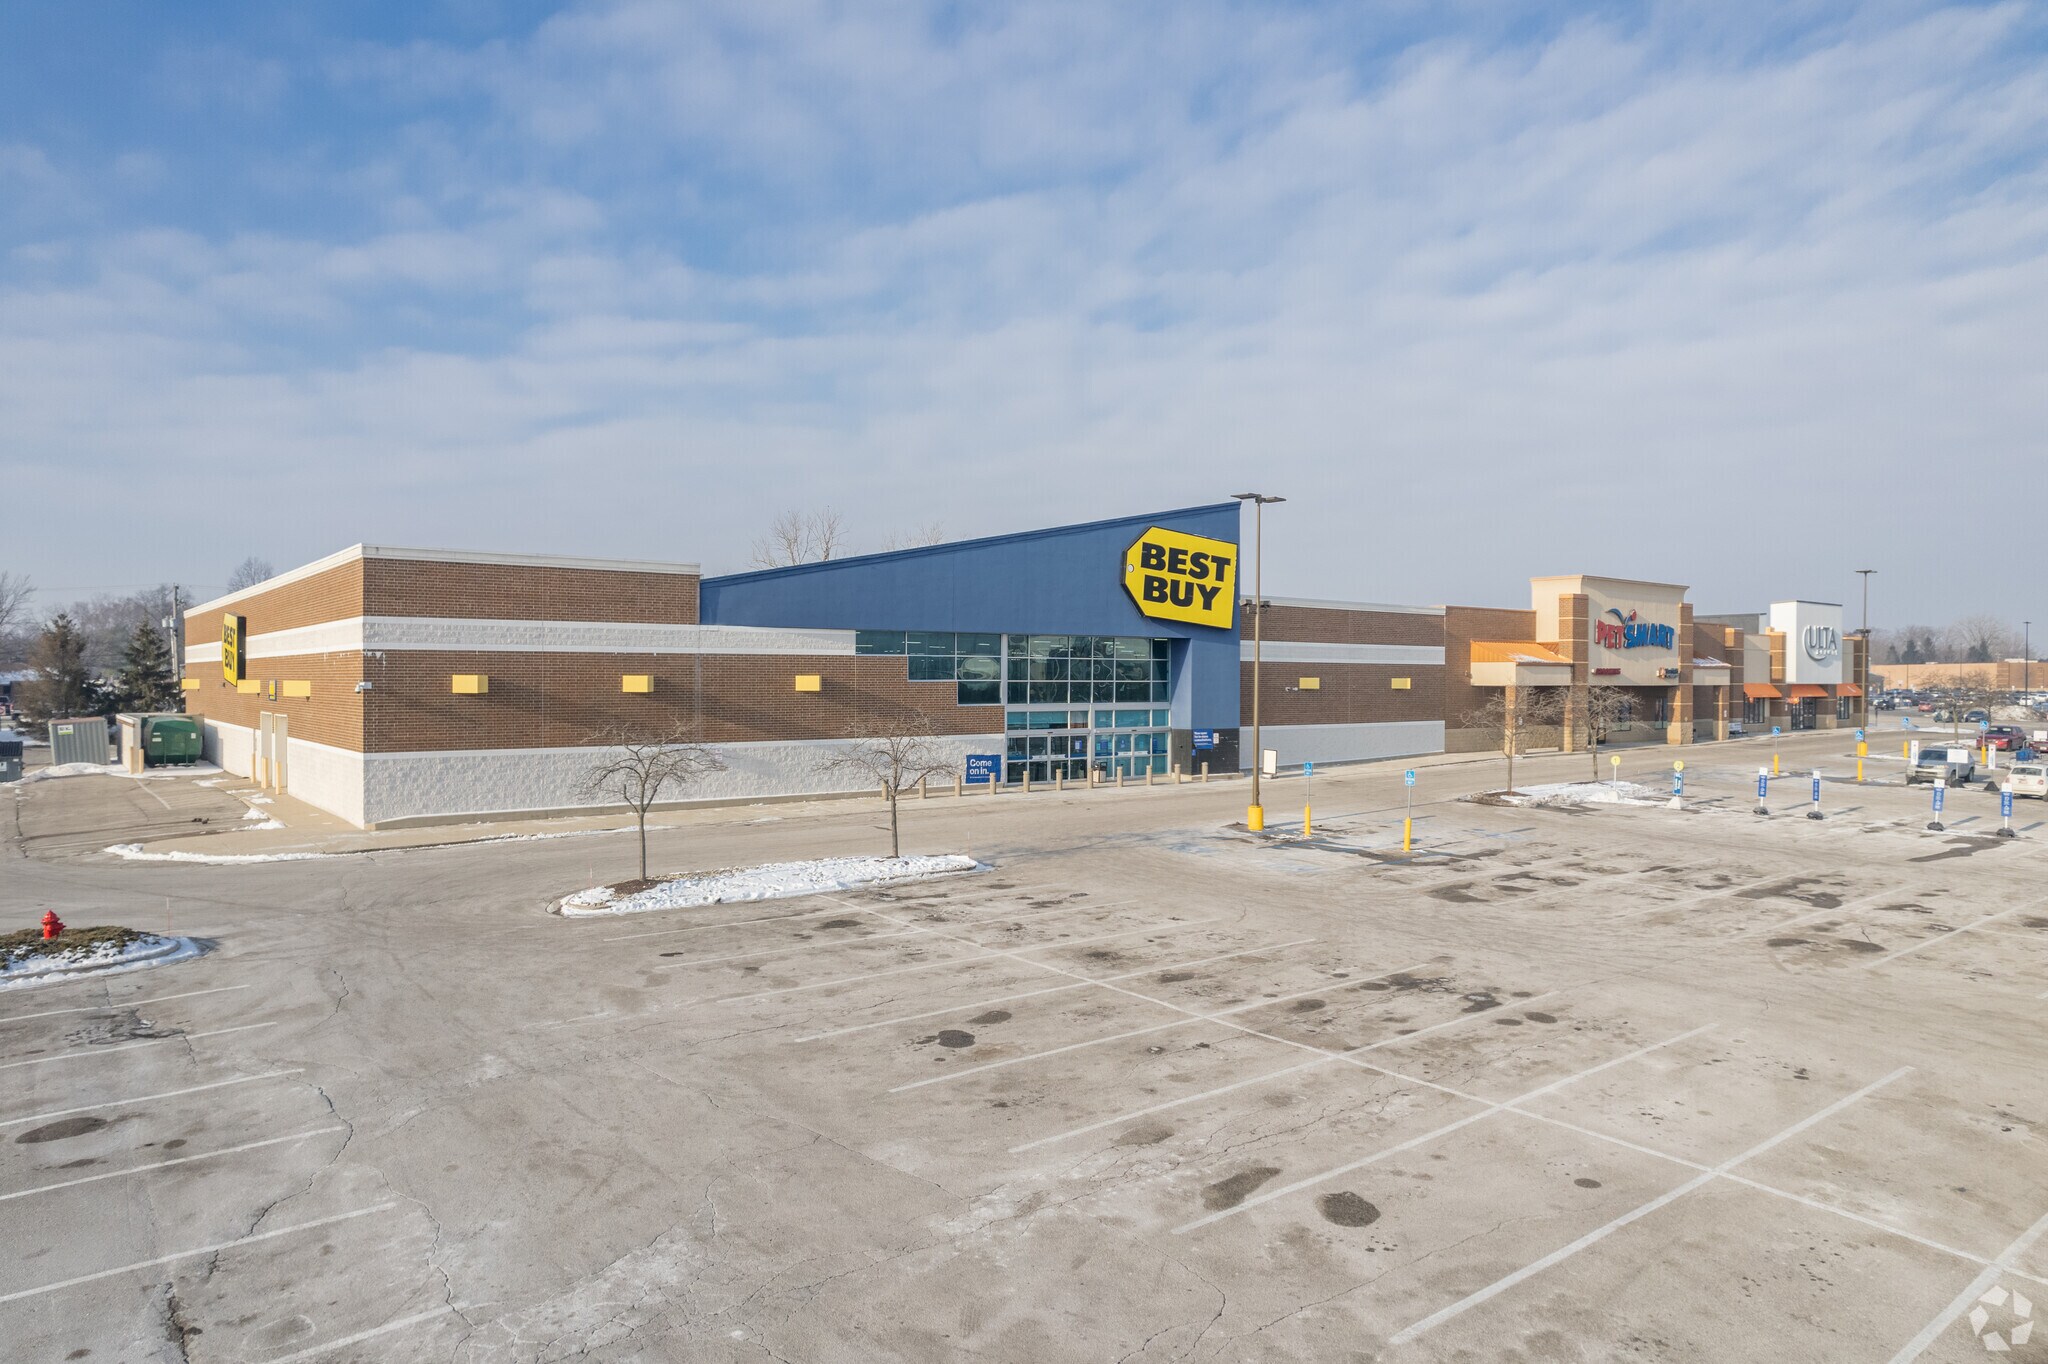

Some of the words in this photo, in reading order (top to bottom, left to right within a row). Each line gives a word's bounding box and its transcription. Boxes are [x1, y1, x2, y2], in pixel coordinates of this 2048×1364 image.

[1141, 541, 1231, 582] BEST
[1143, 574, 1222, 611] BUY
[1595, 619, 1675, 650] PETSMART
[1807, 625, 1837, 650] ULTA
[970, 758, 992, 767] Come
